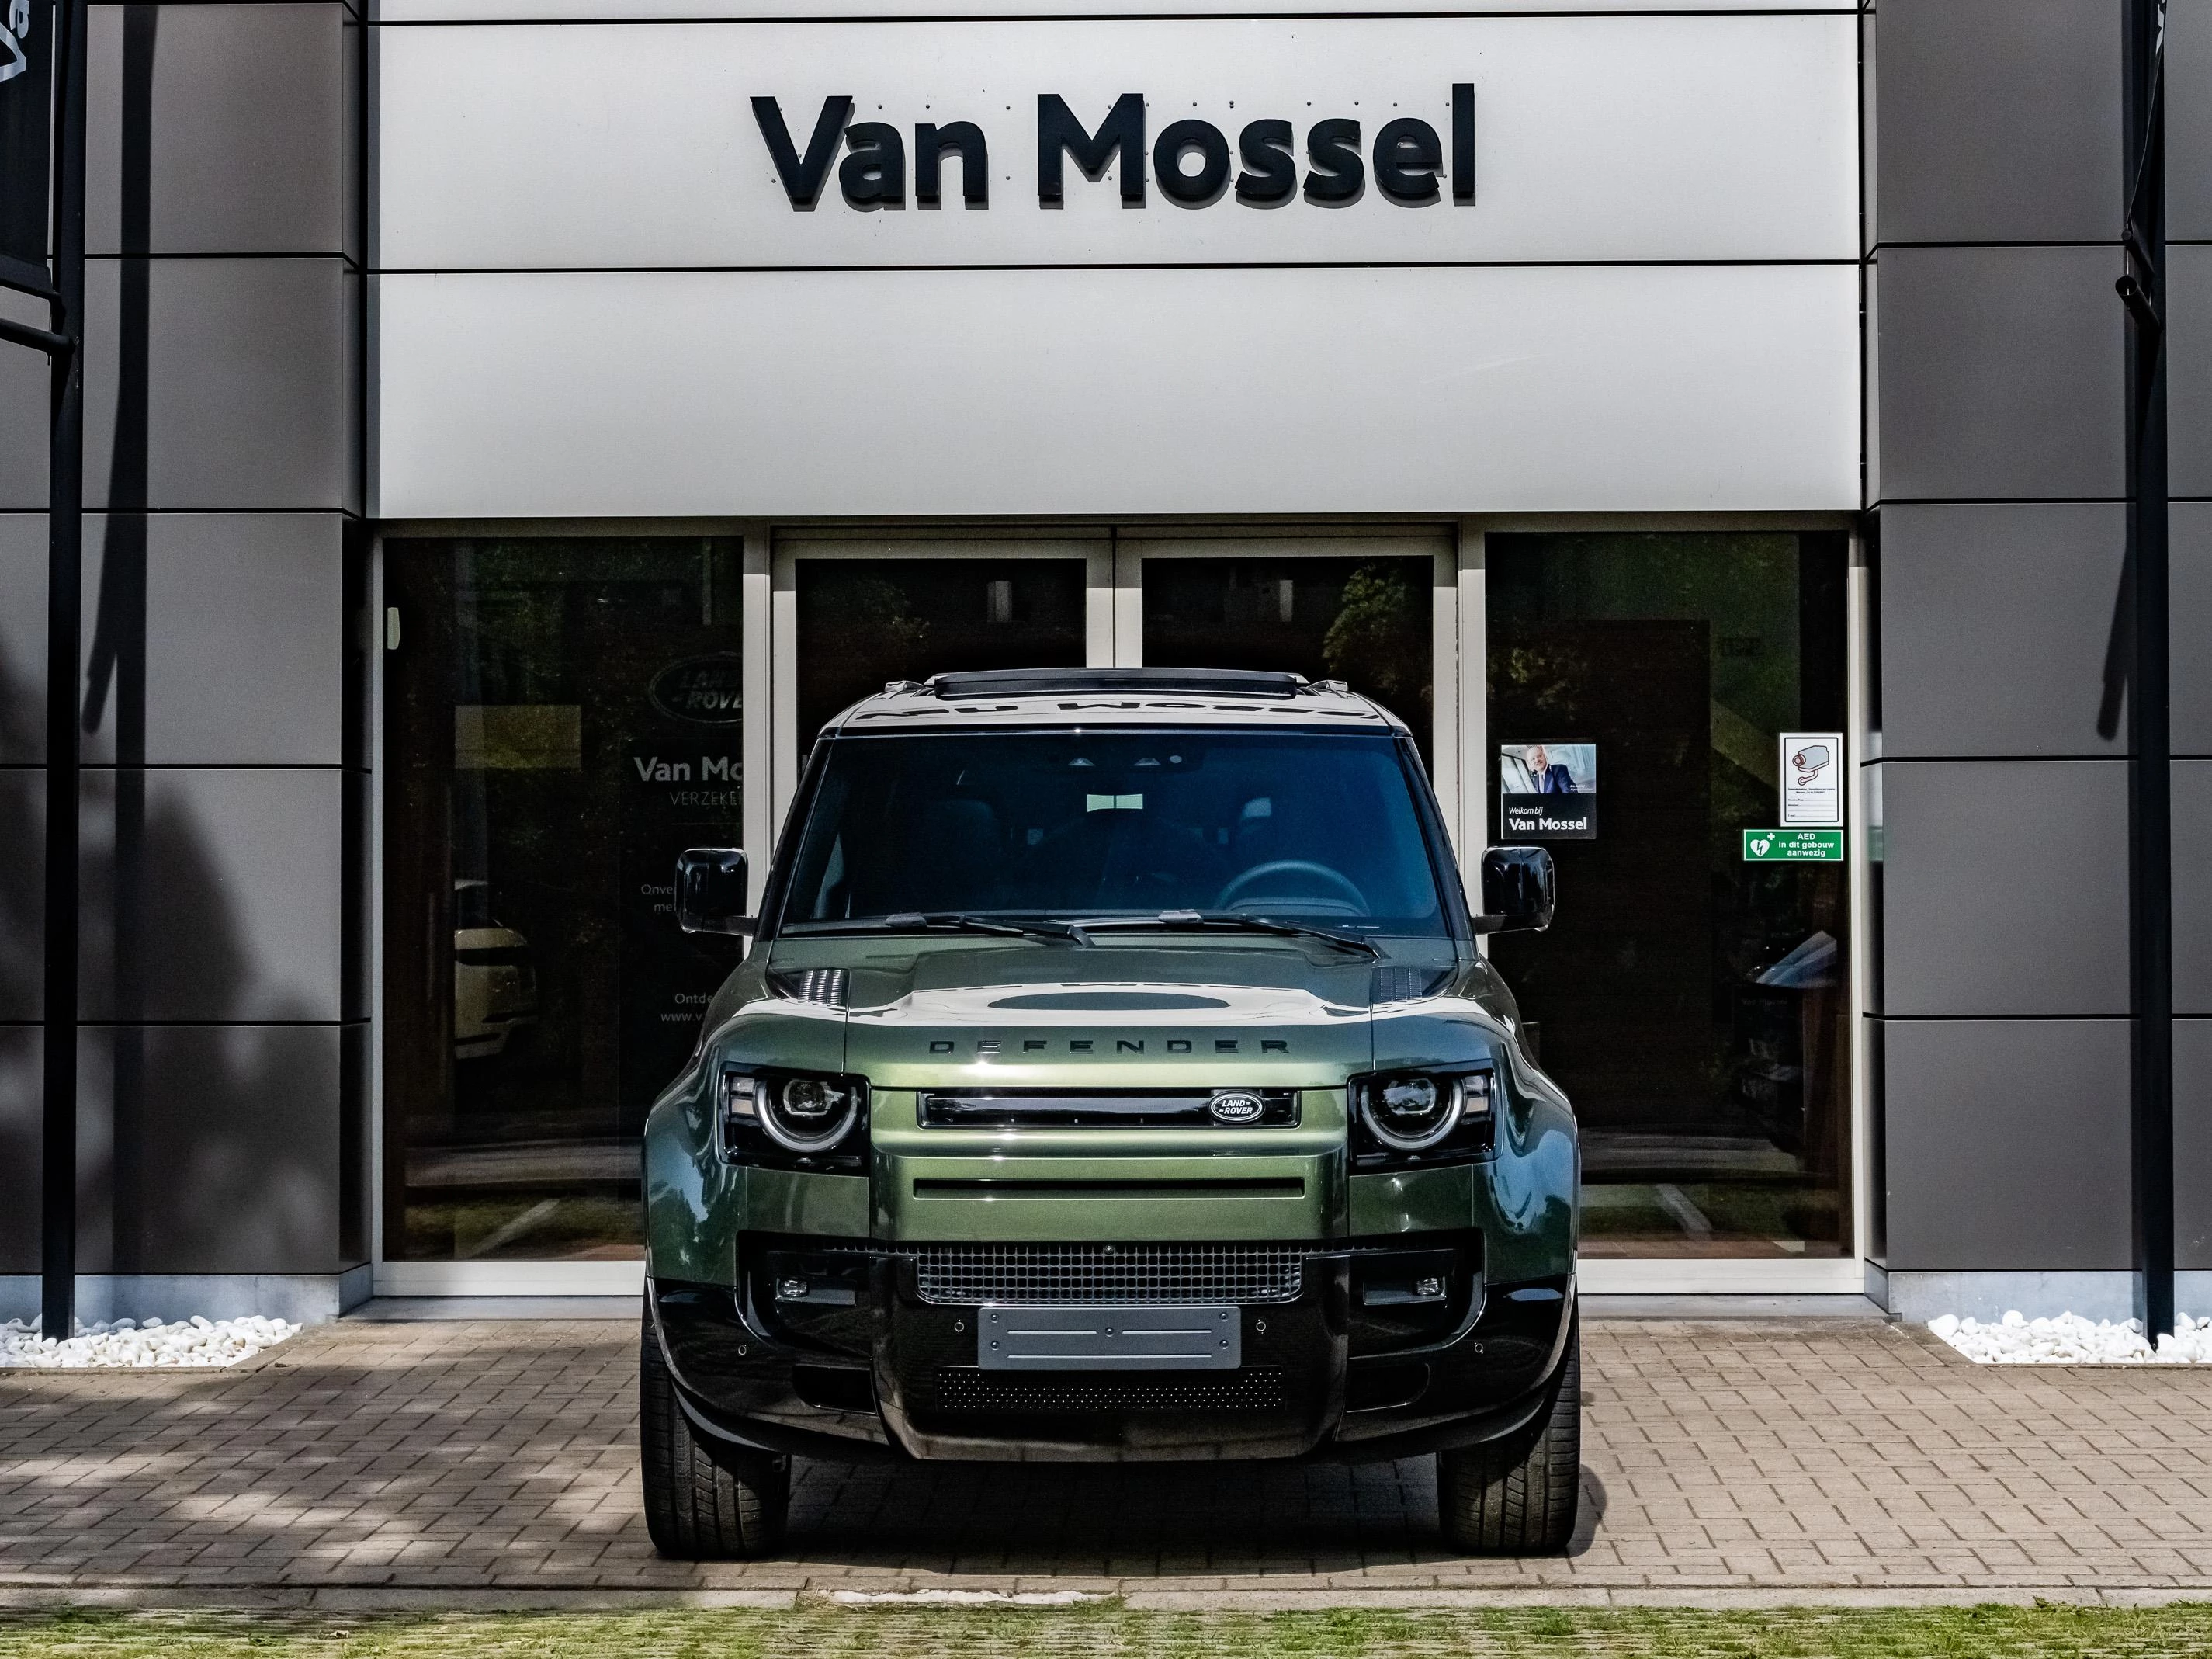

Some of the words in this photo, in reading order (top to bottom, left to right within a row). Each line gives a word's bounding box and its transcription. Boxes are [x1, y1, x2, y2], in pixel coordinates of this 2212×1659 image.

[750, 95, 989, 205] Van
[1037, 83, 1475, 205] Mossel
[633, 756, 690, 782] Van
[669, 791, 743, 806] VERZEKE
[1534, 807, 1543, 816] bij
[1509, 818, 1535, 831] Van
[1539, 817, 1587, 831] Mossel
[1802, 841, 1834, 850] gebouw
[640, 883, 674, 894] Onve
[674, 993, 713, 1004] Ontde
[660, 1013, 703, 1022] www.v
[929, 1040, 1290, 1054] DEFENDER
